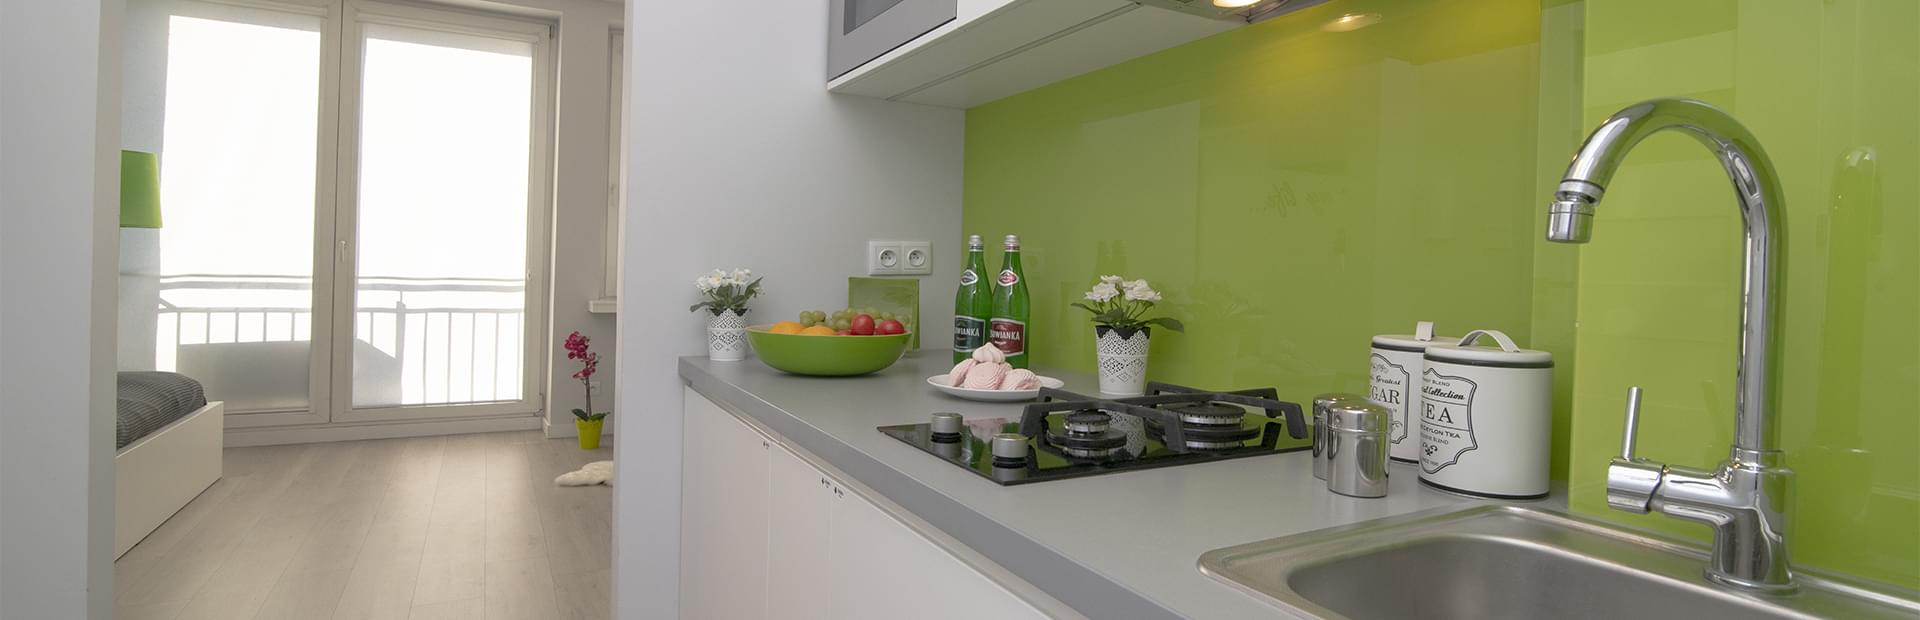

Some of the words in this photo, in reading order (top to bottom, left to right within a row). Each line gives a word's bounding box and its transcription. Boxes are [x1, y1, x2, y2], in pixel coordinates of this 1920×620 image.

[1369, 384, 1400, 404] GAR
[1428, 386, 1465, 400] Collection
[1445, 430, 1461, 439] TEA
